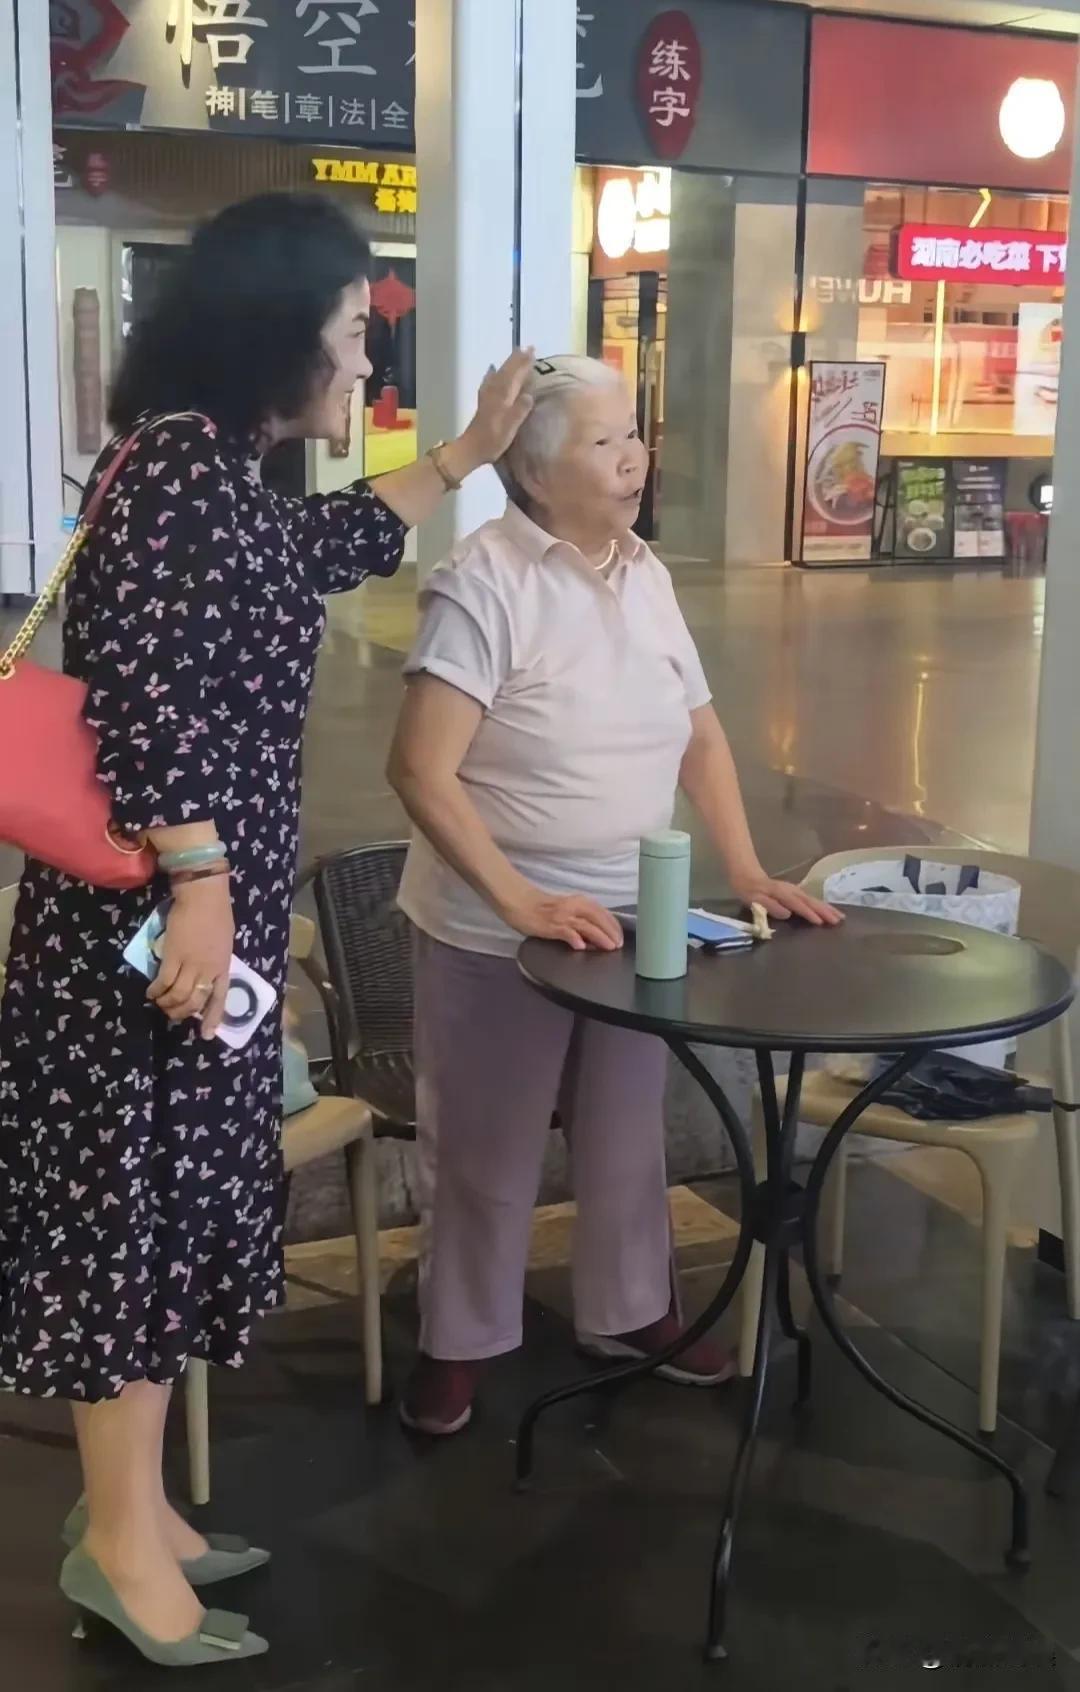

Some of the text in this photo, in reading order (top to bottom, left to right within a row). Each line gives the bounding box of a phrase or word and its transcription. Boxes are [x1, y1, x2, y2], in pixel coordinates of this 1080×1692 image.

[165, 0, 415, 75] 悟空
[649, 40, 691, 127] 练字
[312, 158, 379, 184] YMM
